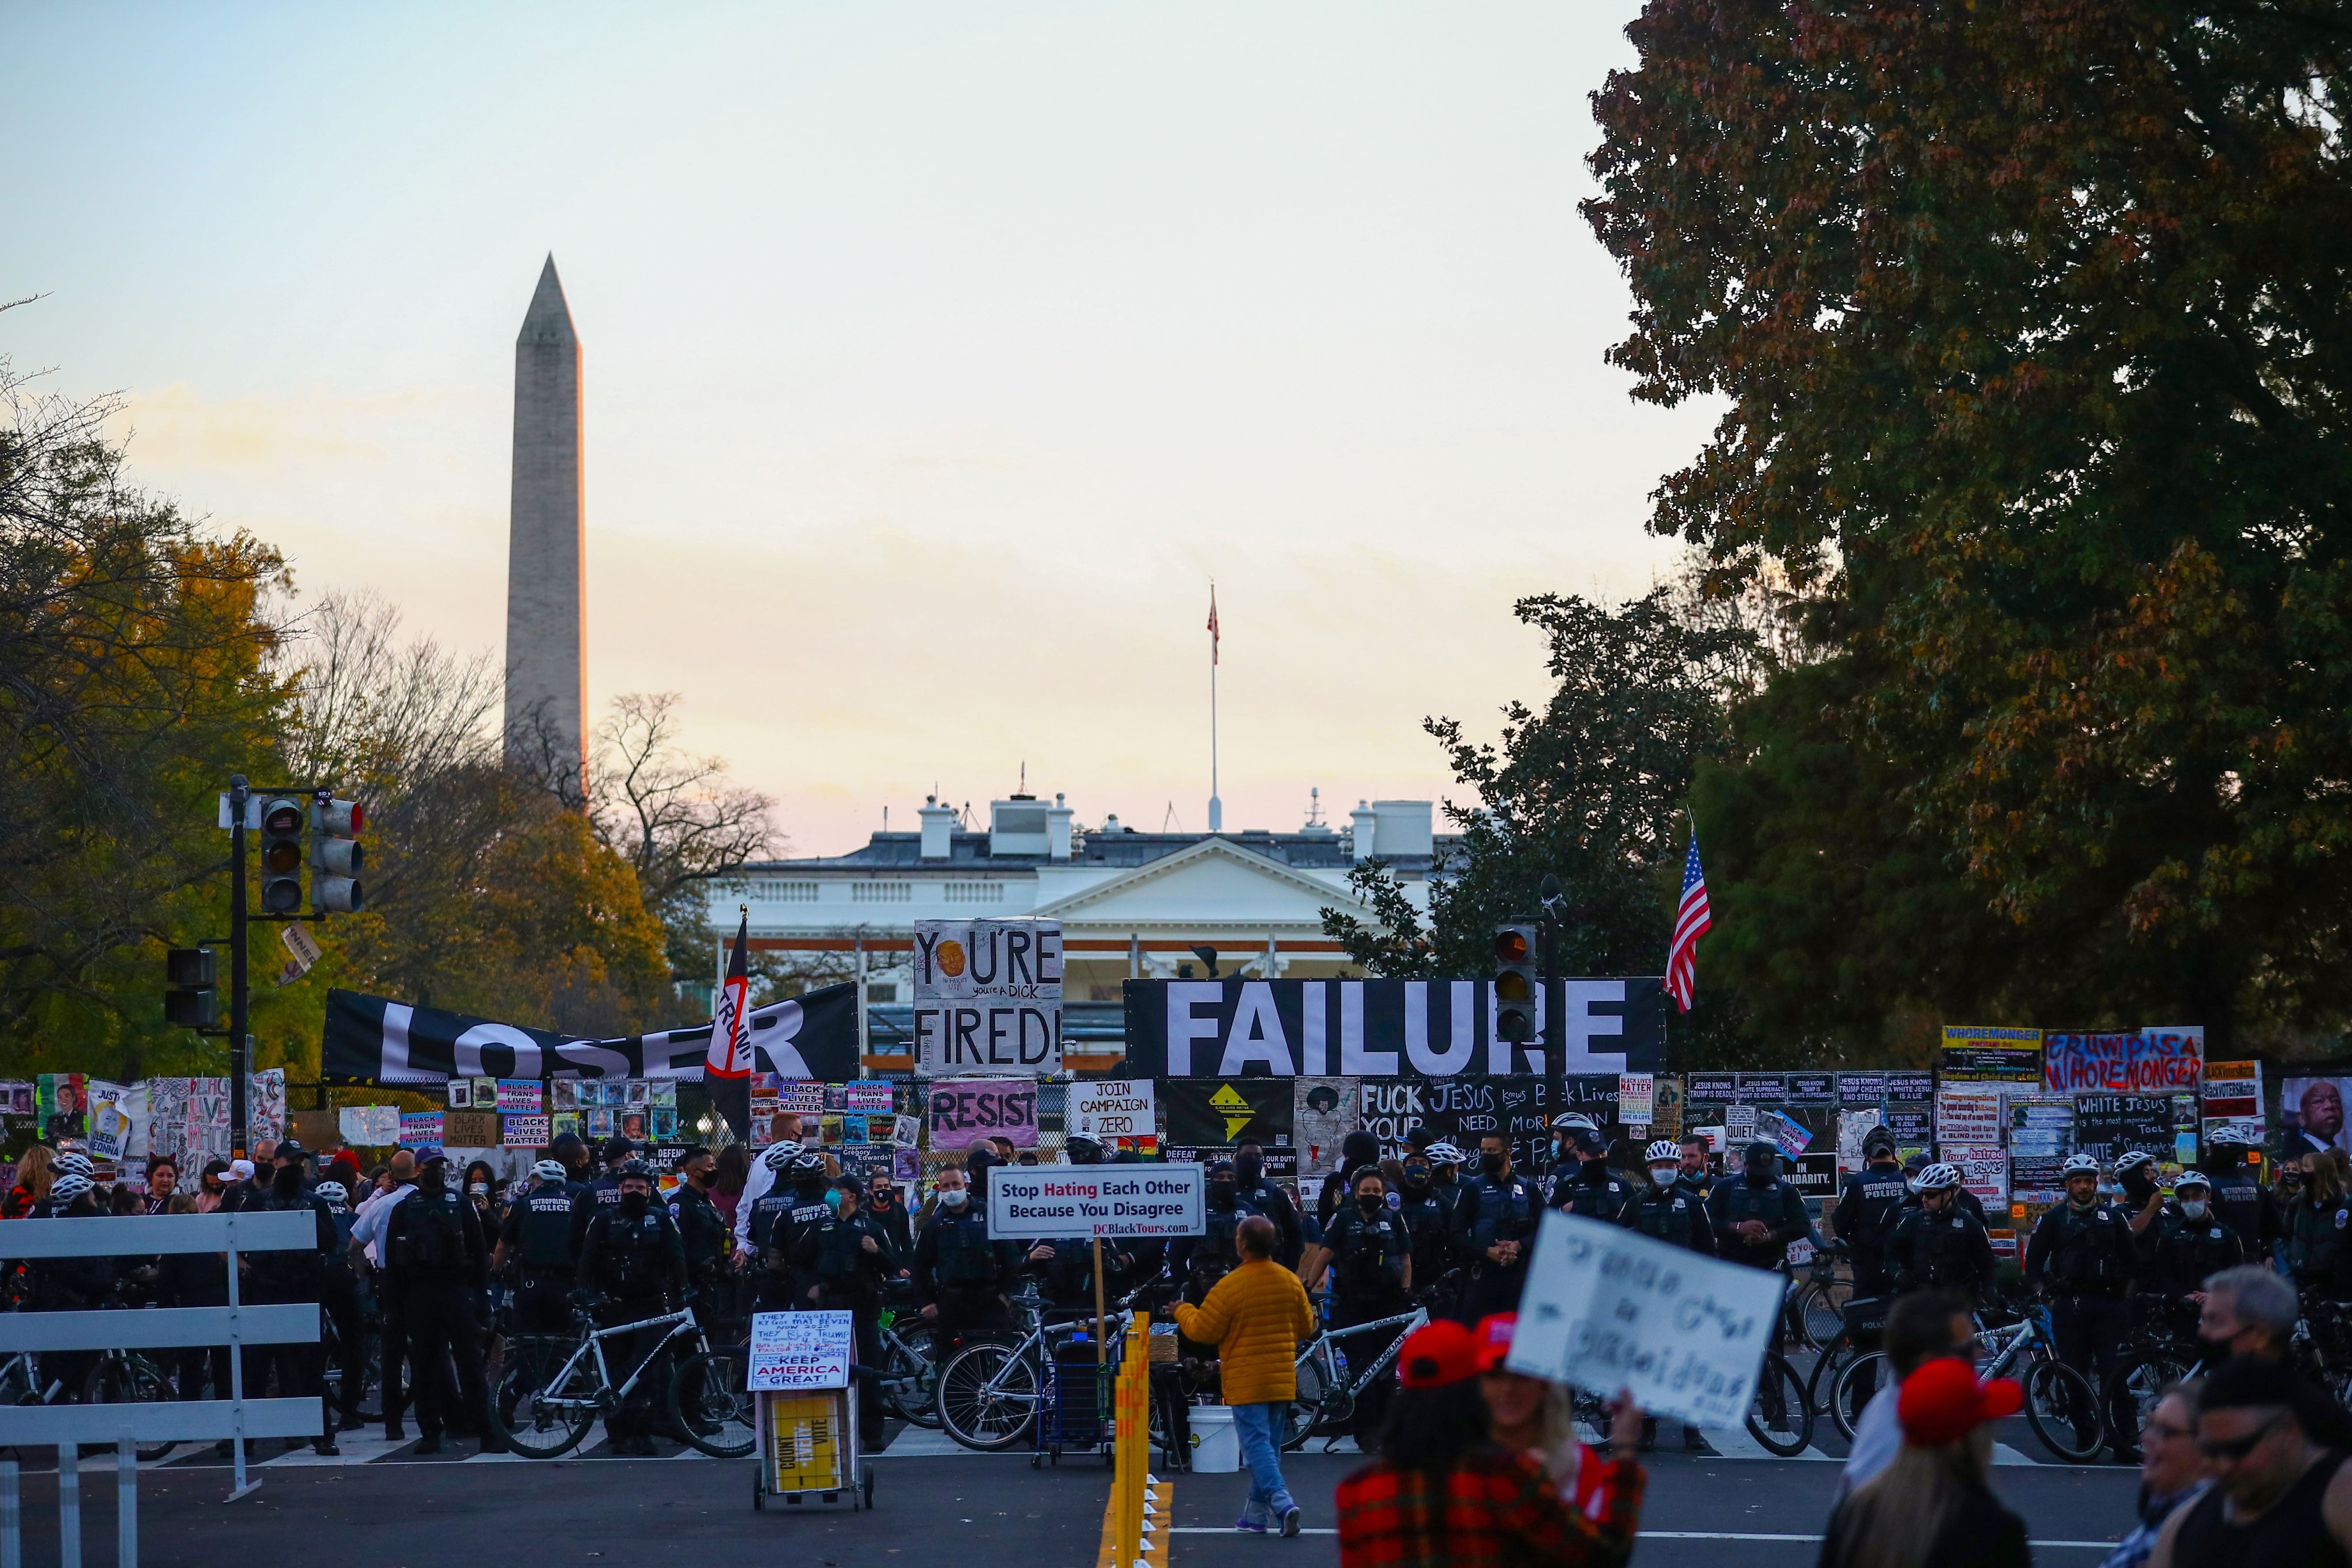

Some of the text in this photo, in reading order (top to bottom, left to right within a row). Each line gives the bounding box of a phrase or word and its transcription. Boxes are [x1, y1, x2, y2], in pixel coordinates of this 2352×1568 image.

[916, 928, 1060, 984] YU'RE
[1000, 986, 1007, 995] A
[380, 999, 811, 1083] LOSER
[914, 1008, 1061, 1064] FIRED!
[2181, 1036, 2197, 1057] A
[2046, 1056, 2201, 1093] WHOREMONGER
[190, 1078, 231, 1095] BLACK
[1096, 1083, 1130, 1096] JOIN
[1361, 1084, 1424, 1114] FUCK
[1430, 1083, 1494, 1112] JESUS
[1580, 1082, 1619, 1102] Lives
[931, 1092, 1036, 1131] RESIST
[1081, 1099, 1148, 1112] CAMPAIGN
[2079, 1097, 2120, 1114] WHITE
[455, 1114, 485, 1124] BLACK
[1098, 1117, 1132, 1133] ZERO
[1459, 1115, 1497, 1132] NEED
[2079, 1118, 2086, 1127] is
[2092, 1115, 2102, 1125] the
[2124, 1117, 2154, 1127] important
[454, 1124, 484, 1134] LIVES
[1727, 1125, 1754, 1138] QUIET.
[92, 1132, 117, 1145] QUEEN
[450, 1135, 486, 1147] MATTER
[2113, 1133, 2121, 1142] of
[1943, 1148, 2004, 1162] Your hatred
[2076, 1138, 2175, 1163] WHITE SUPREMACY
[650, 1158, 673, 1167] BLACK
[1797, 1163, 1807, 1173] IN
[1782, 1173, 1830, 1184] OLIDARITY.
[1002, 1180, 1191, 1200] Stop Hating Each Other
[1863, 1182, 1905, 1192] METROPOLITAN
[1865, 1190, 1904, 1199] POLICE
[530, 1197, 570, 1206] METROPOLITAN
[1010, 1201, 1183, 1219] Because You Disagree
[1093, 1223, 1189, 1235] DCBlackTours.com
[649, 1314, 674, 1323] POLICE
[1374, 1316, 1401, 1326] POLICE
[757, 1365, 841, 1375] AMERICA
[770, 1375, 827, 1383] GREAT!
[811, 1419, 828, 1446] VOTE
[794, 1427, 814, 1461] EVERY
[778, 1435, 795, 1470] COUNT
